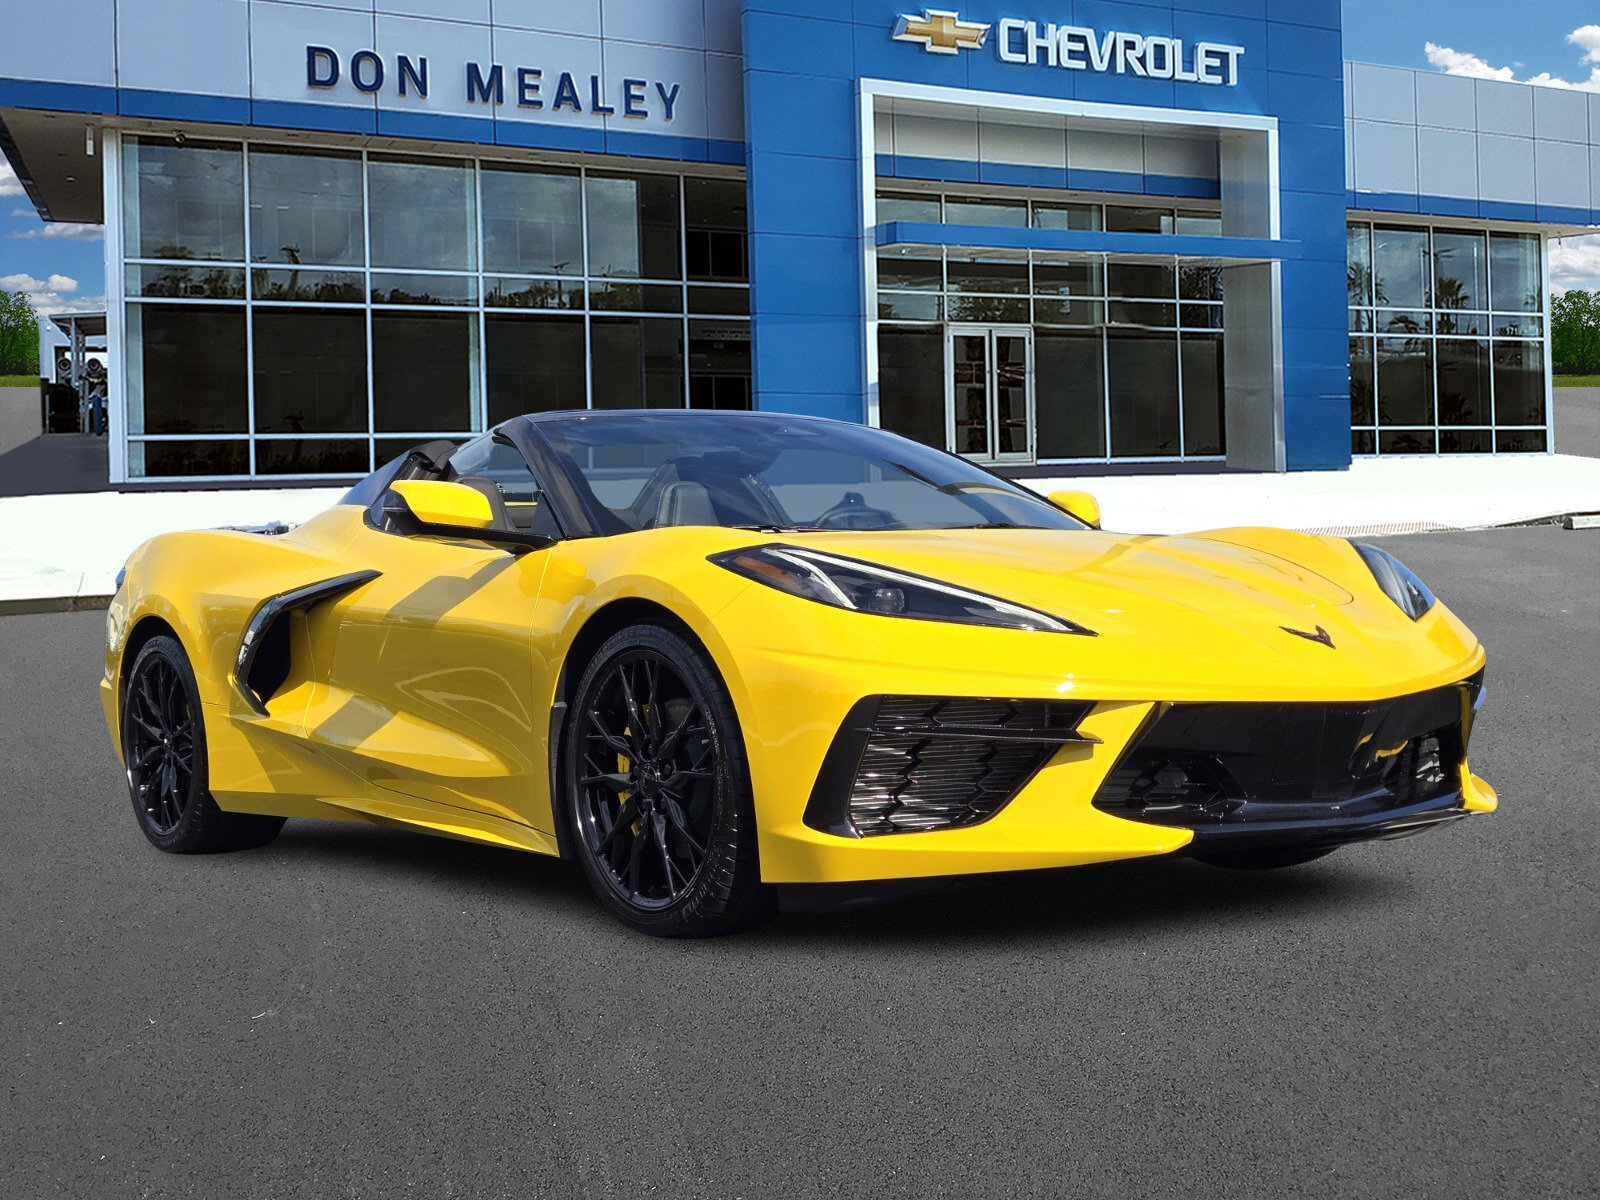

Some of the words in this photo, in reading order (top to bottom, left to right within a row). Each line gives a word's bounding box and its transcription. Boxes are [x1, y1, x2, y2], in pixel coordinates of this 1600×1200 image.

[306, 45, 428, 99] DON
[466, 62, 680, 122] MEALEY
[997, 17, 1245, 87] CHEVROLET
